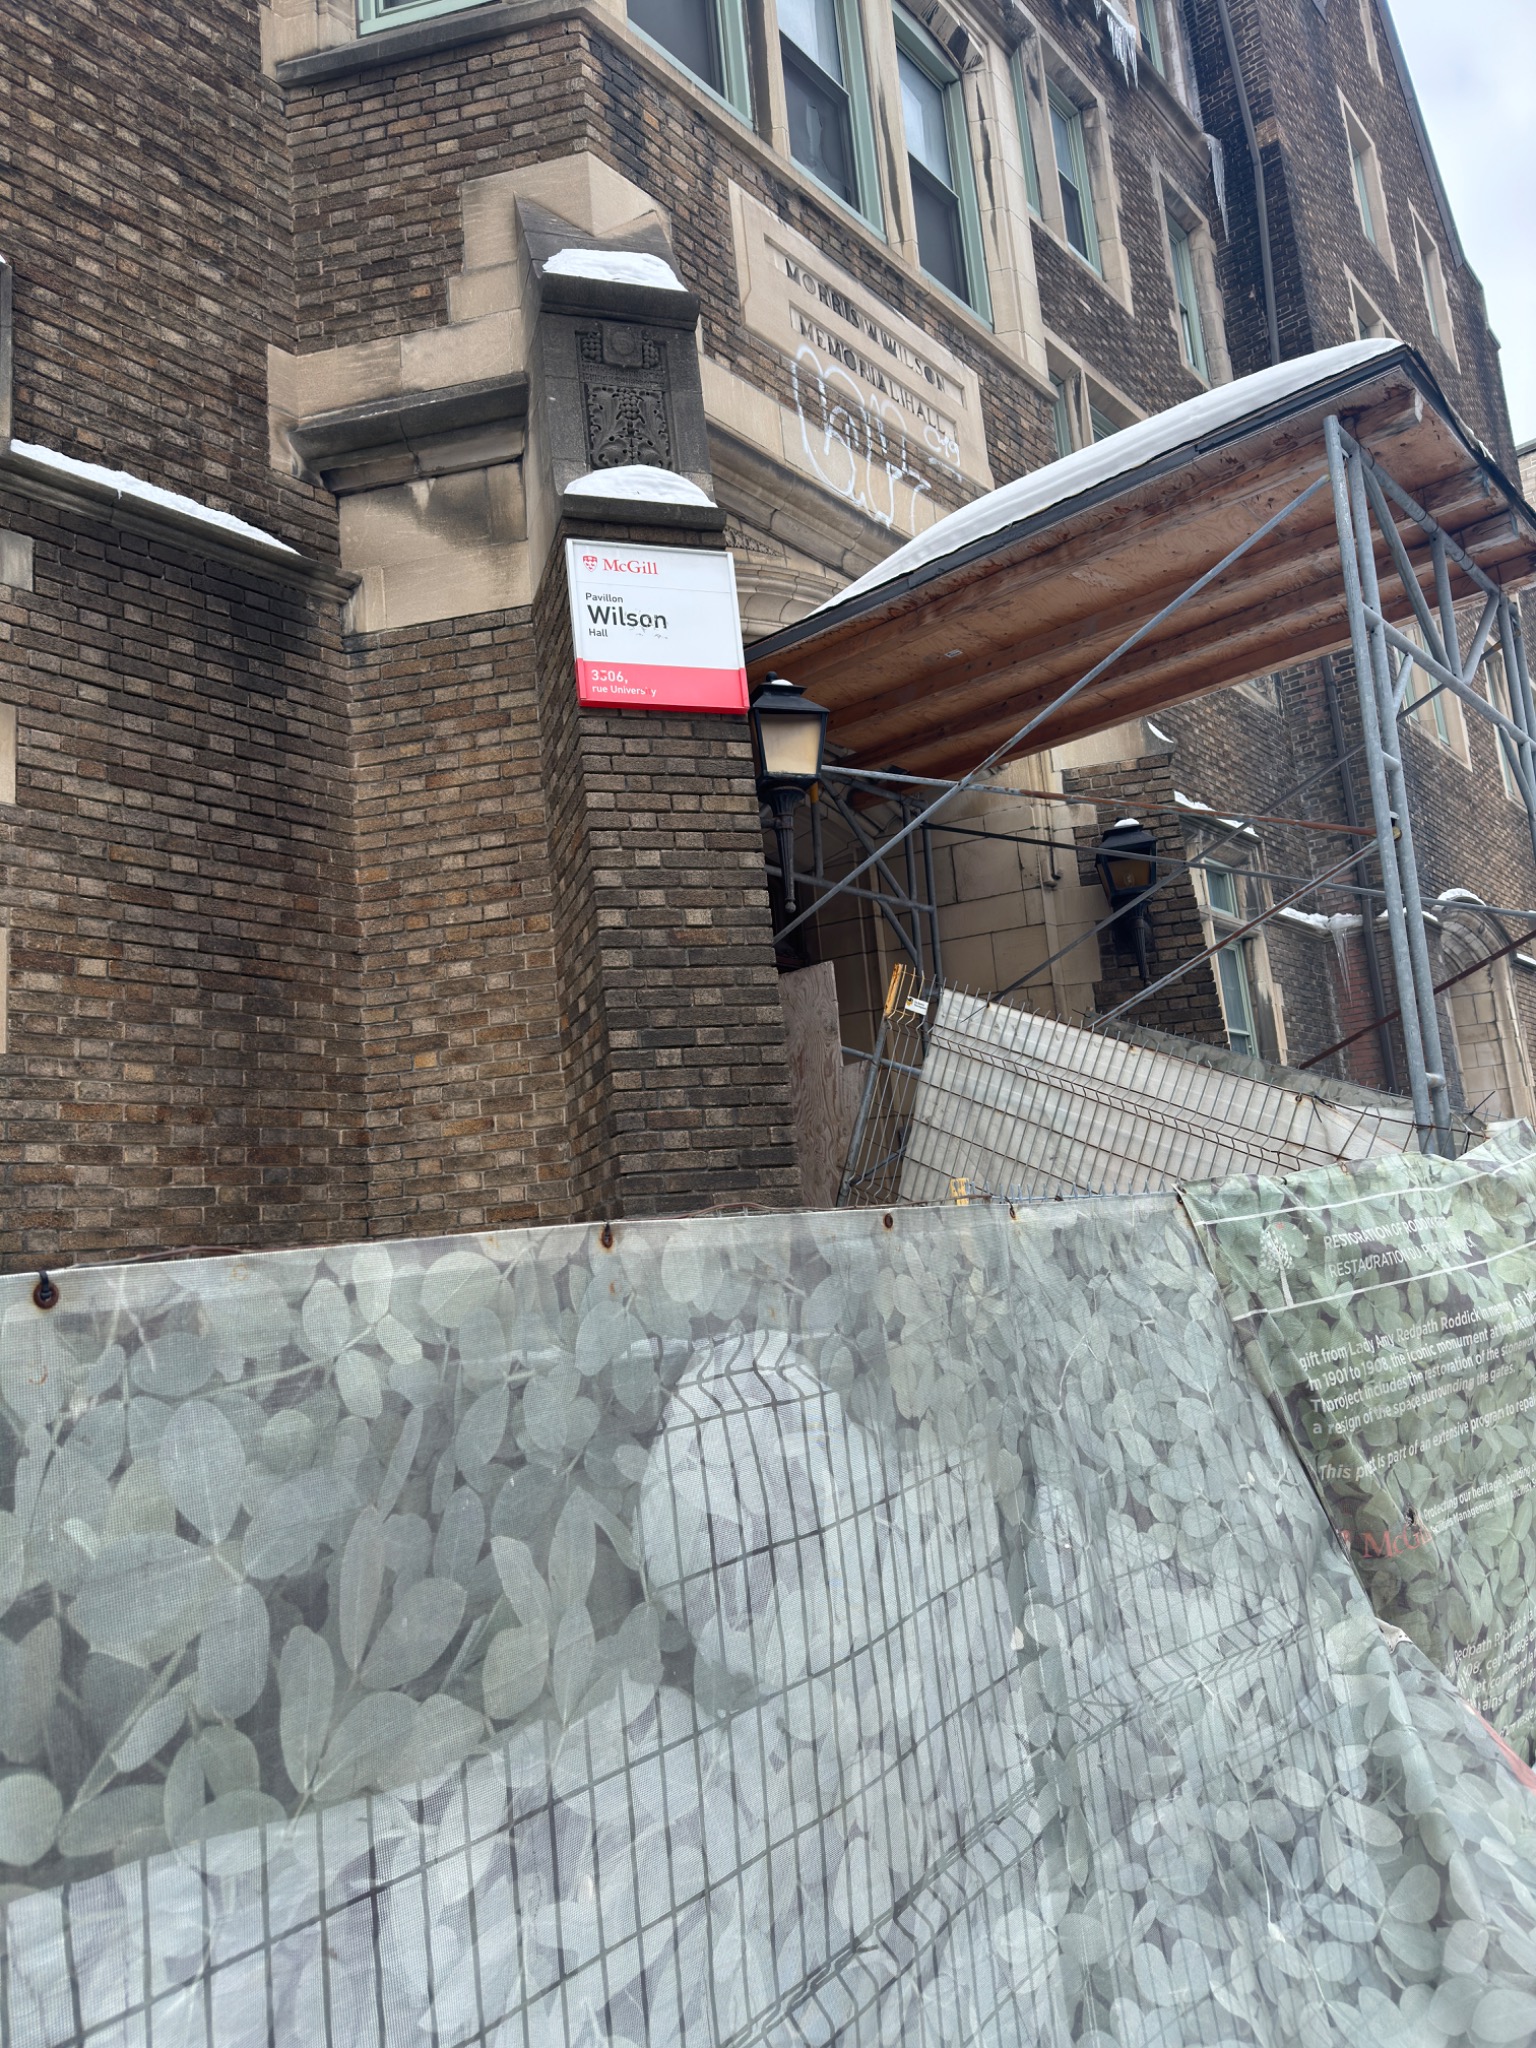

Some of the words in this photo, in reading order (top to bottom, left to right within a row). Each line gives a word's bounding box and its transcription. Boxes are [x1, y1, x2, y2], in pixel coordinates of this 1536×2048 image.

[784, 257, 860, 329] MORRIS
[880, 328, 946, 393] WILSON
[800, 314, 900, 404] MEMORIAL
[899, 386, 946, 435] HALL
[602, 558, 659, 575] McGill
[585, 592, 624, 603] Pavillon
[587, 604, 667, 629] Wilson
[588, 628, 609, 637] Hall
[592, 685, 608, 693] rue
[610, 685, 657, 697] Universy
[1323, 1223, 1395, 1250] RESTORATION
[1328, 1249, 1410, 1278] RESTAURATION
[1299, 1351, 1320, 1371] gift
[1321, 1346, 1348, 1363] from
[1348, 1338, 1375, 1355] Lady
[1375, 1333, 1394, 1348] Amy
[1396, 1319, 1439, 1342] Redpath
[1440, 1308, 1481, 1330] Roddick
[1513, 1292, 1526, 1307] of
[1322, 1368, 1349, 1387] 1901
[1349, 1366, 1361, 1380] to
[1390, 1352, 1407, 1368] the
[1406, 1343, 1437, 1363] iconic
[1436, 1328, 1488, 1353] monument
[1364, 1377, 1408, 1400] includes
[1408, 1370, 1423, 1386] the
[1424, 1355, 1474, 1380] restoration
[1475, 1350, 1485, 1365] of
[1486, 1347, 1500, 1361] the
[1501, 1333, 1536, 1357] stonewor
[1313, 1423, 1322, 1434] a
[1363, 1408, 1373, 1424] of
[1393, 1394, 1421, 1416] space
[1421, 1378, 1475, 1404] surrounding
[1476, 1373, 1489, 1386] the
[1490, 1363, 1516, 1382] gates.
[1319, 1463, 1351, 1481] This
[1377, 1453, 1386, 1468] is
[1388, 1445, 1406, 1468] part
[1408, 1439, 1418, 1456] of
[1420, 1436, 1431, 1452] an
[1432, 1421, 1469, 1446] extensive
[1505, 1403, 1515, 1416] to
[1516, 1392, 1536, 1412] repai
[1458, 1490, 1472, 1504] our
